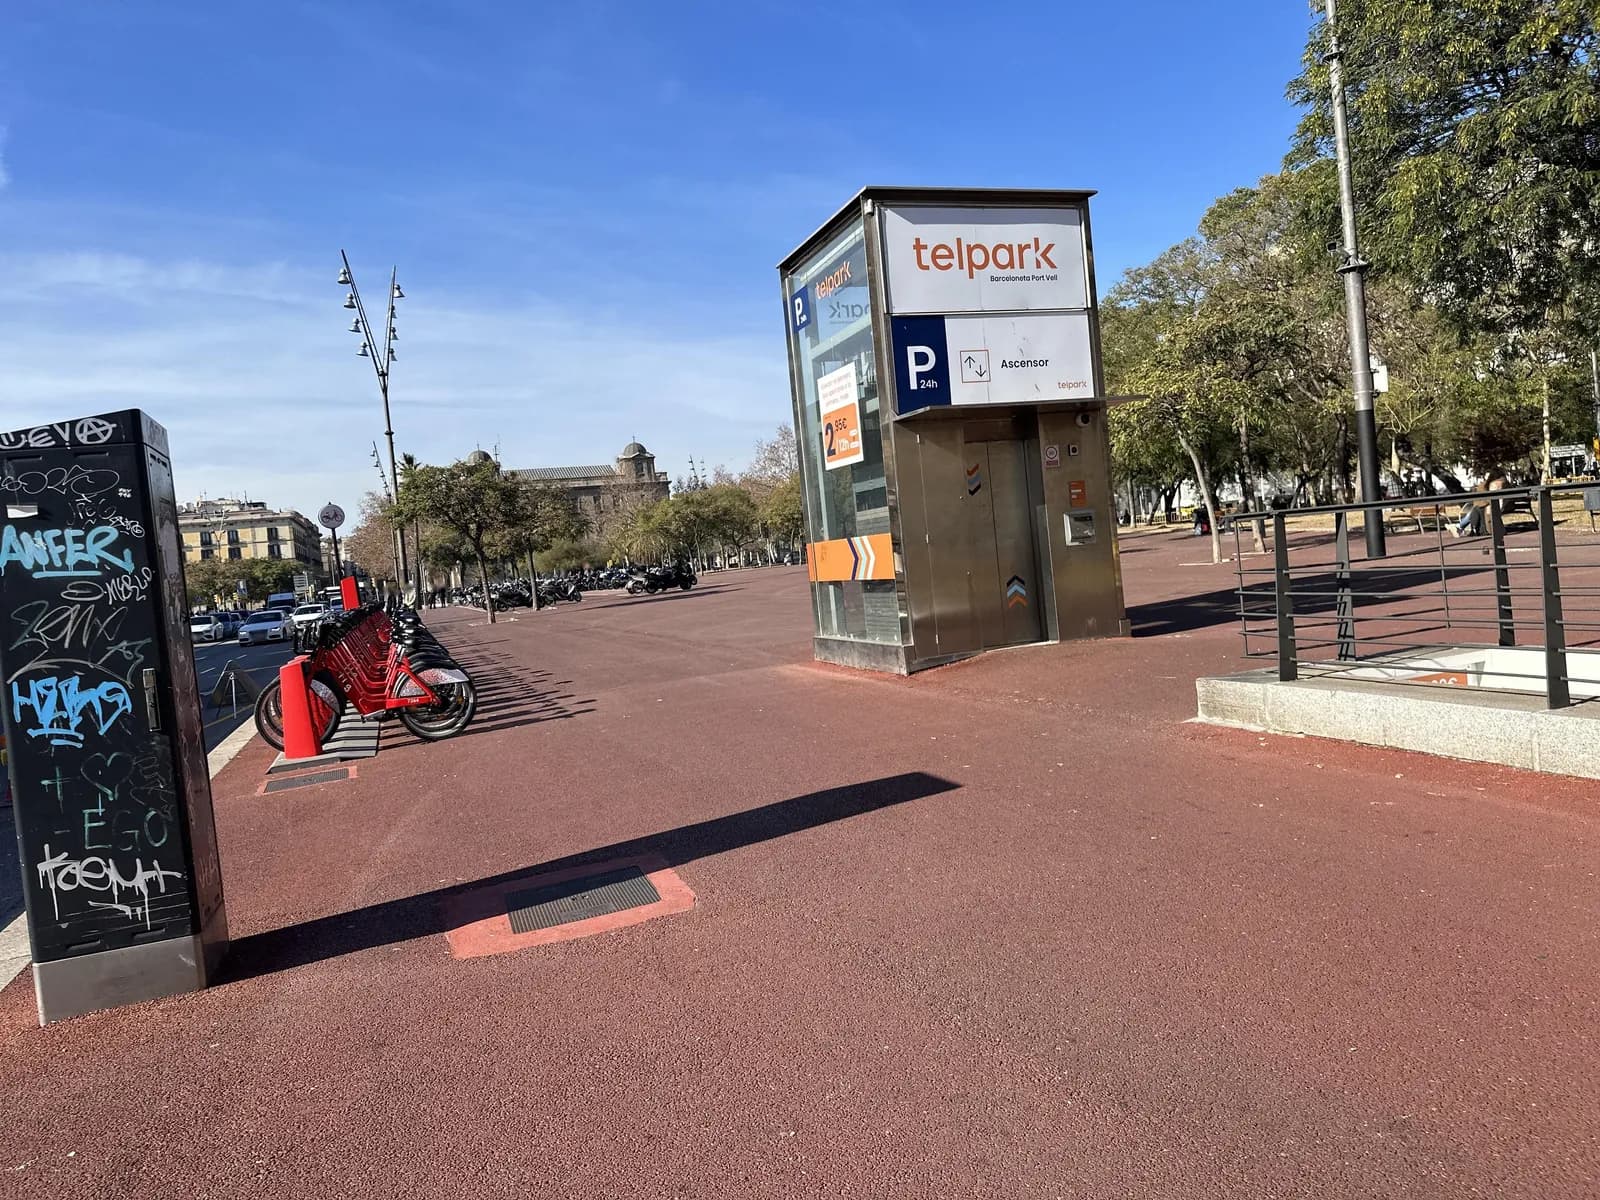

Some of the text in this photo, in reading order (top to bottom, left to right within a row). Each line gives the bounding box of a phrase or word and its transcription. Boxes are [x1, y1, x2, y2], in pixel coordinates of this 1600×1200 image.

[913, 237, 1058, 279] telpark
[816, 261, 852, 299] telpark
[907, 345, 936, 390] P
[1001, 359, 1049, 369] Ascensor
[920, 379, 938, 389] 24h
[1058, 380, 1087, 390] telpark
[825, 422, 836, 457] 2
